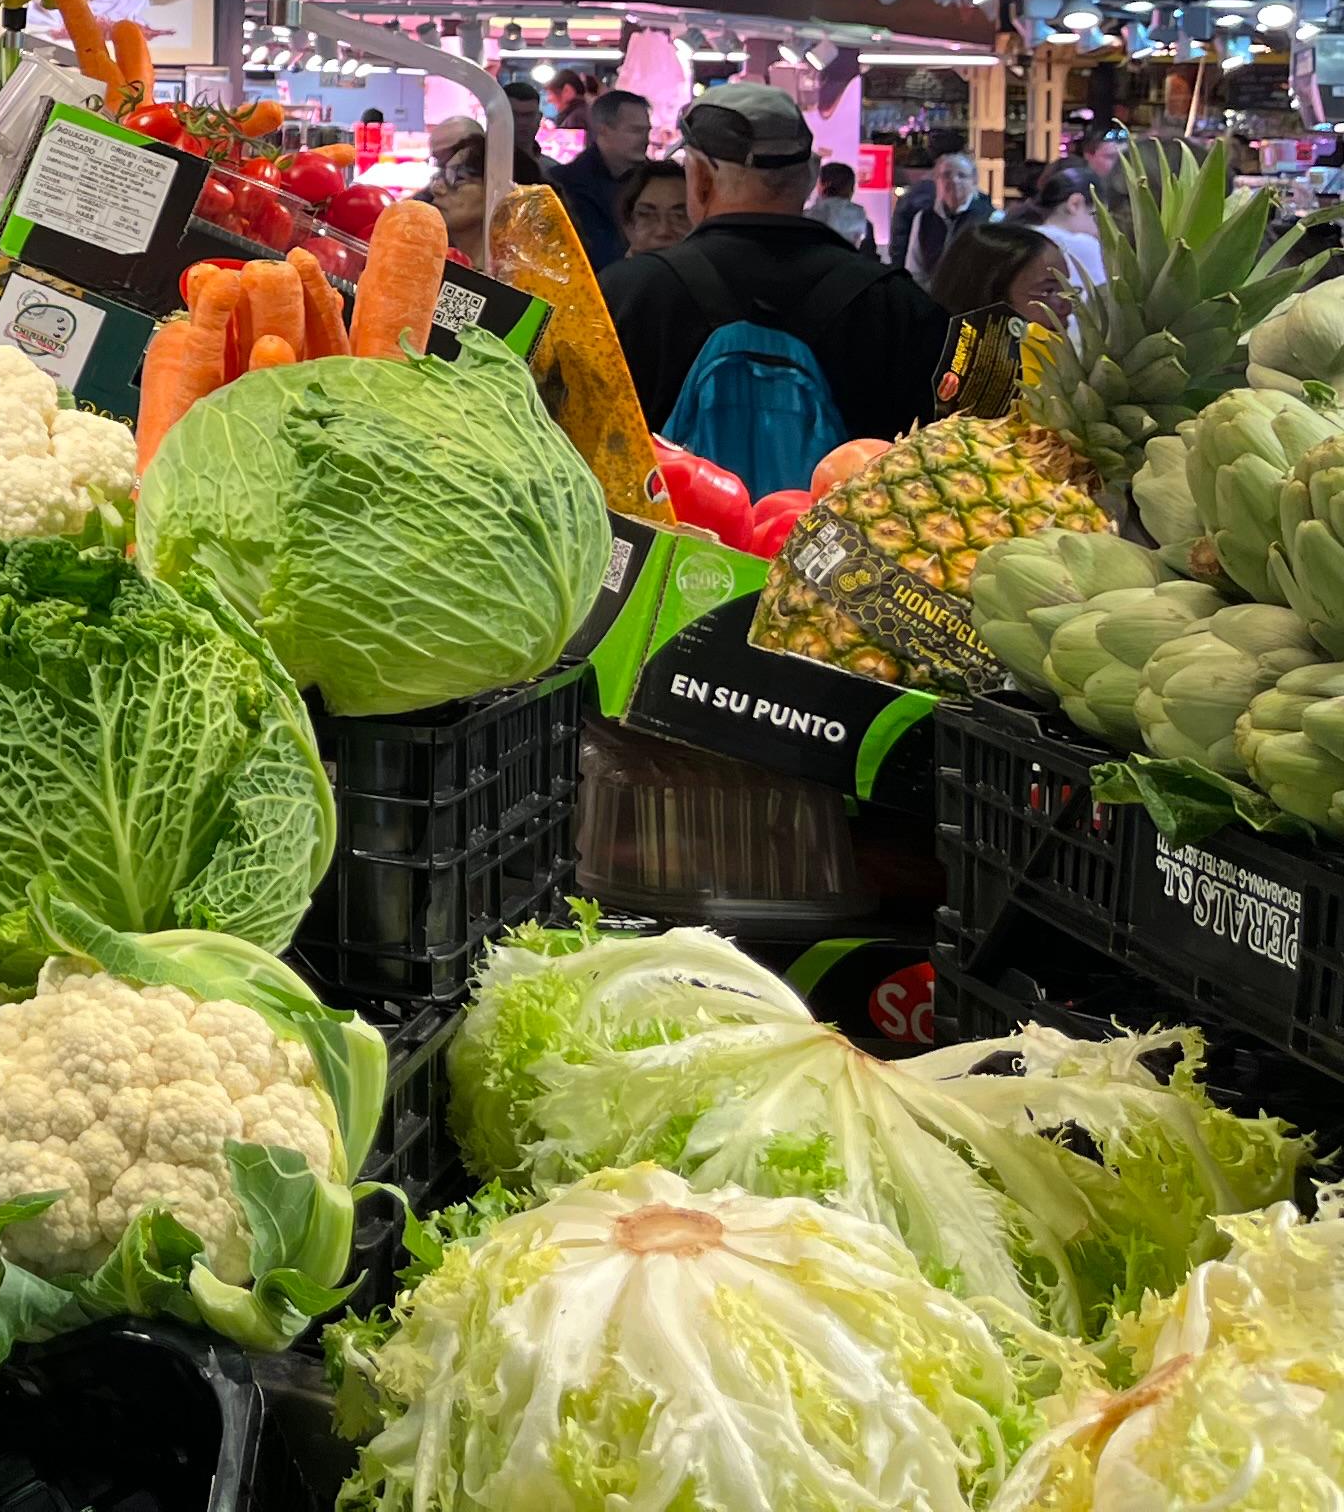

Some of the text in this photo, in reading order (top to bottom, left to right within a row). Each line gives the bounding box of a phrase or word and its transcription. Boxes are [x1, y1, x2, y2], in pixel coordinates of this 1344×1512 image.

[670, 673, 846, 743] EN SU PUNTO
[1193, 875, 1300, 970] PERALS
